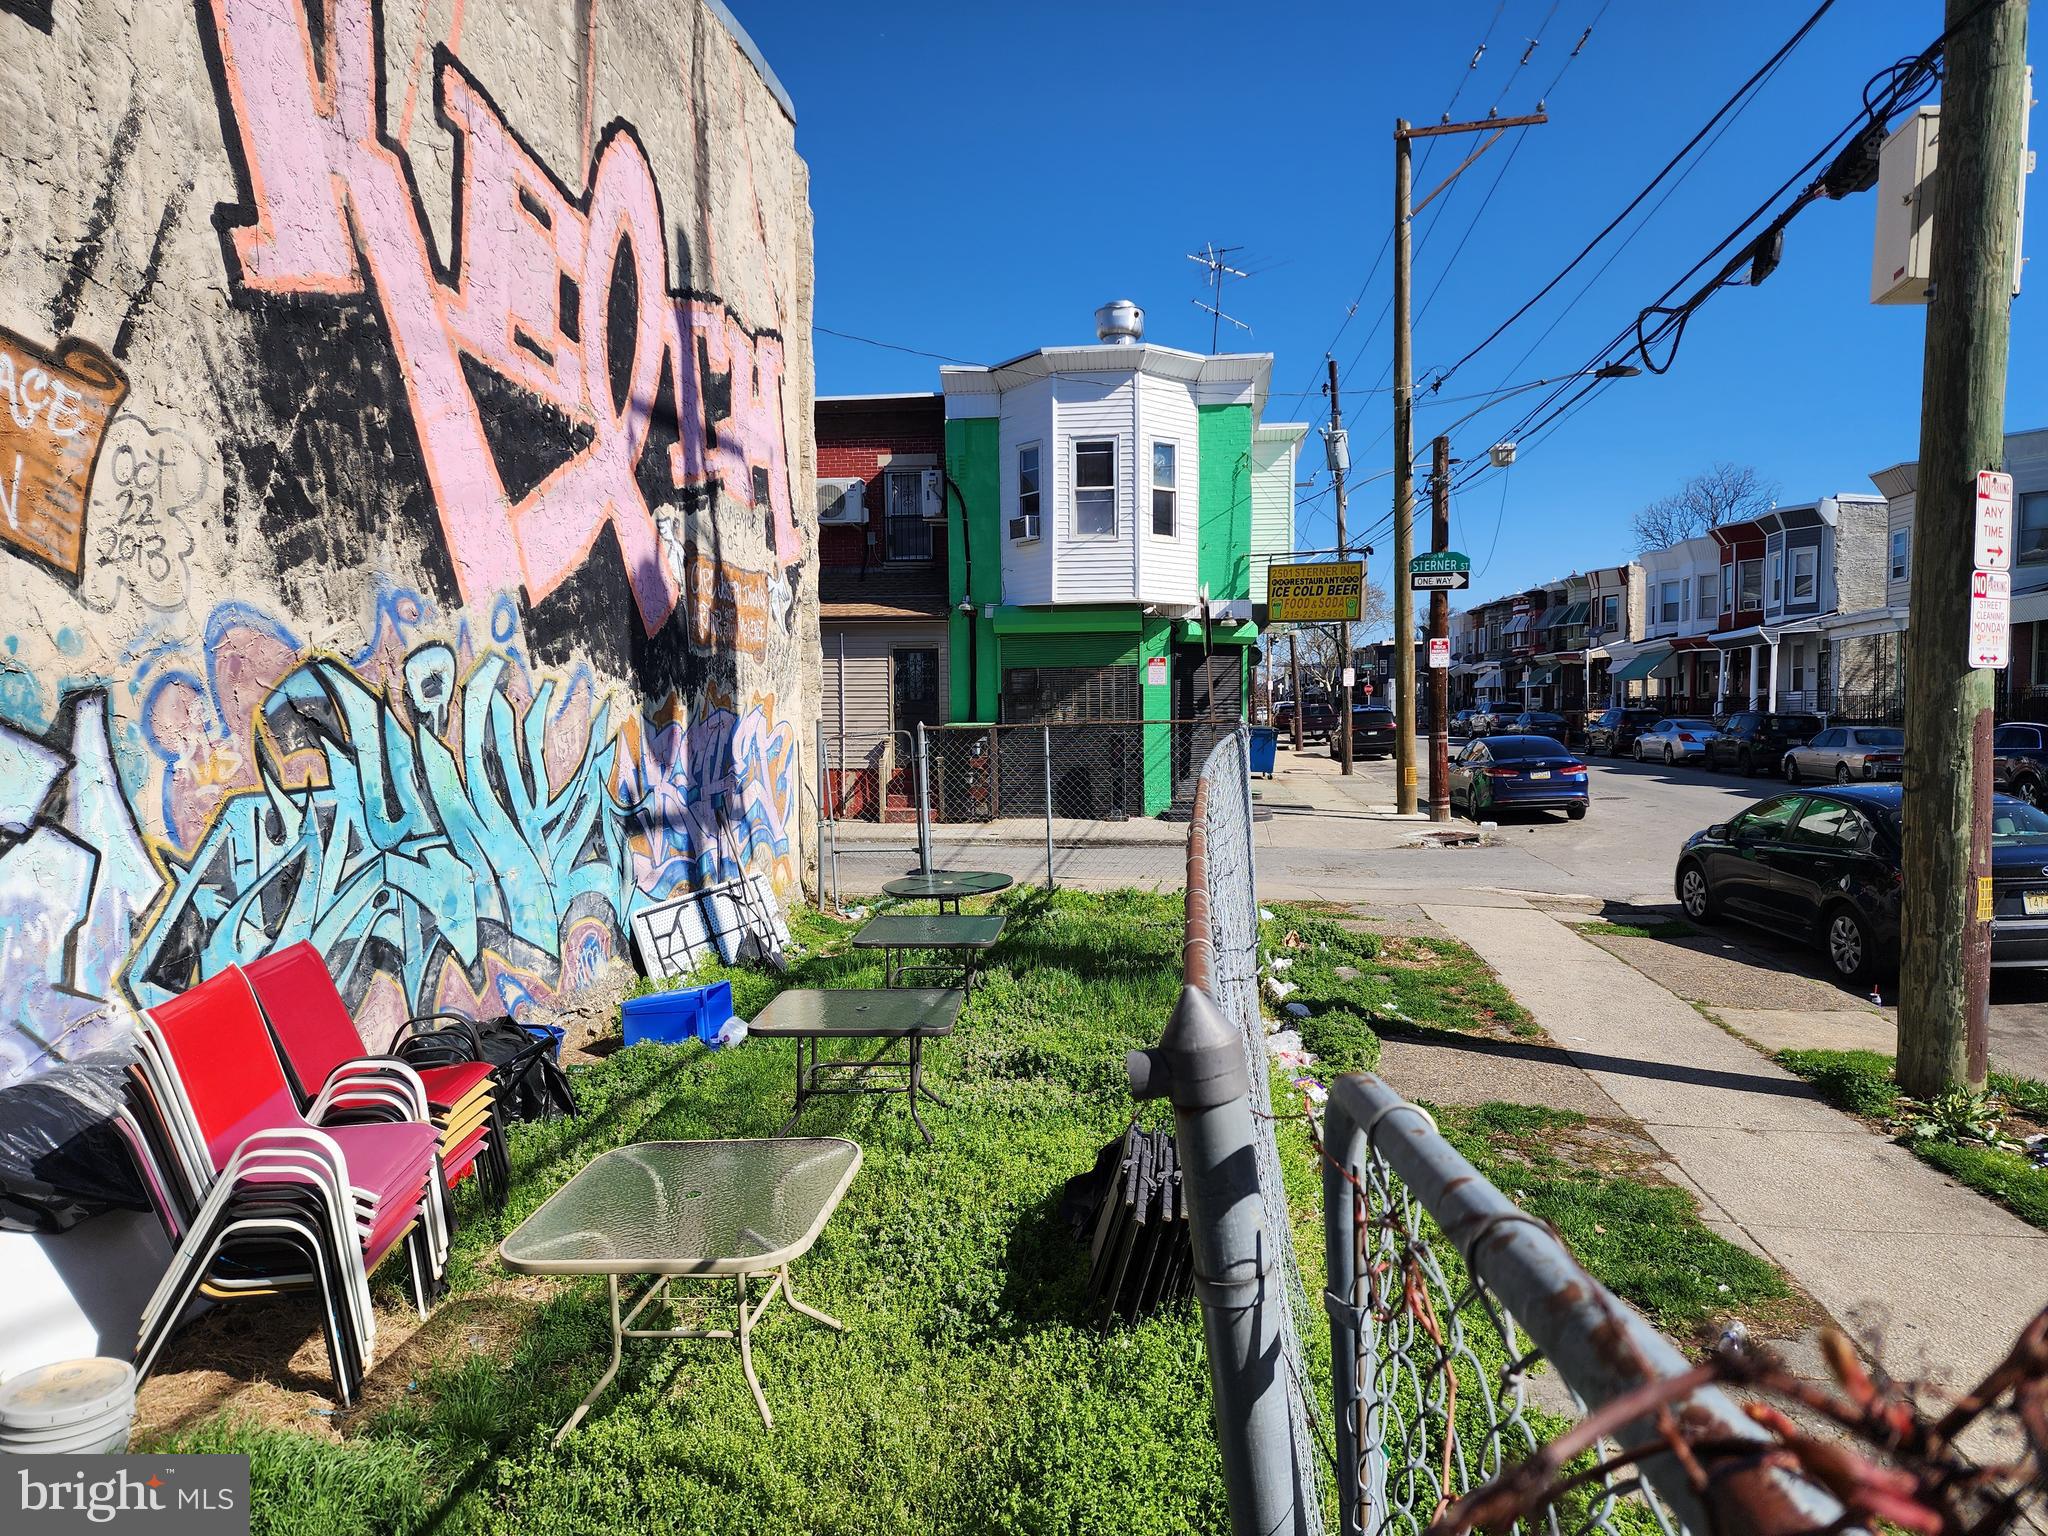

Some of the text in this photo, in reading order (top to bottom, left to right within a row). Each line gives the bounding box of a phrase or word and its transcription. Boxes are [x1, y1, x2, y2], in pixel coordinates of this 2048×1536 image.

[111, 444, 177, 499] Oct
[1980, 476, 1990, 496] NO
[116, 489, 162, 528] 22
[1984, 506, 2004, 519] ANY
[1984, 525, 2004, 538] TIME
[99, 526, 172, 583] 2013
[1412, 559, 1469, 571] STERNER ST
[1272, 565, 1360, 579] 2501 STERNER INC.
[1290, 576, 1341, 586] RESTAURANT
[1417, 577, 1434, 585] ONE
[1975, 575, 1986, 594] NO
[1272, 584, 1359, 597] ICE COLD BEER
[1284, 596, 1345, 609] FOOD & SODA
[1979, 601, 2001, 610] STREET
[1284, 610, 1344, 619] 215-221-5450
[1976, 611, 2005, 620] CLEANING
[1974, 622, 2005, 633] MONDAY
